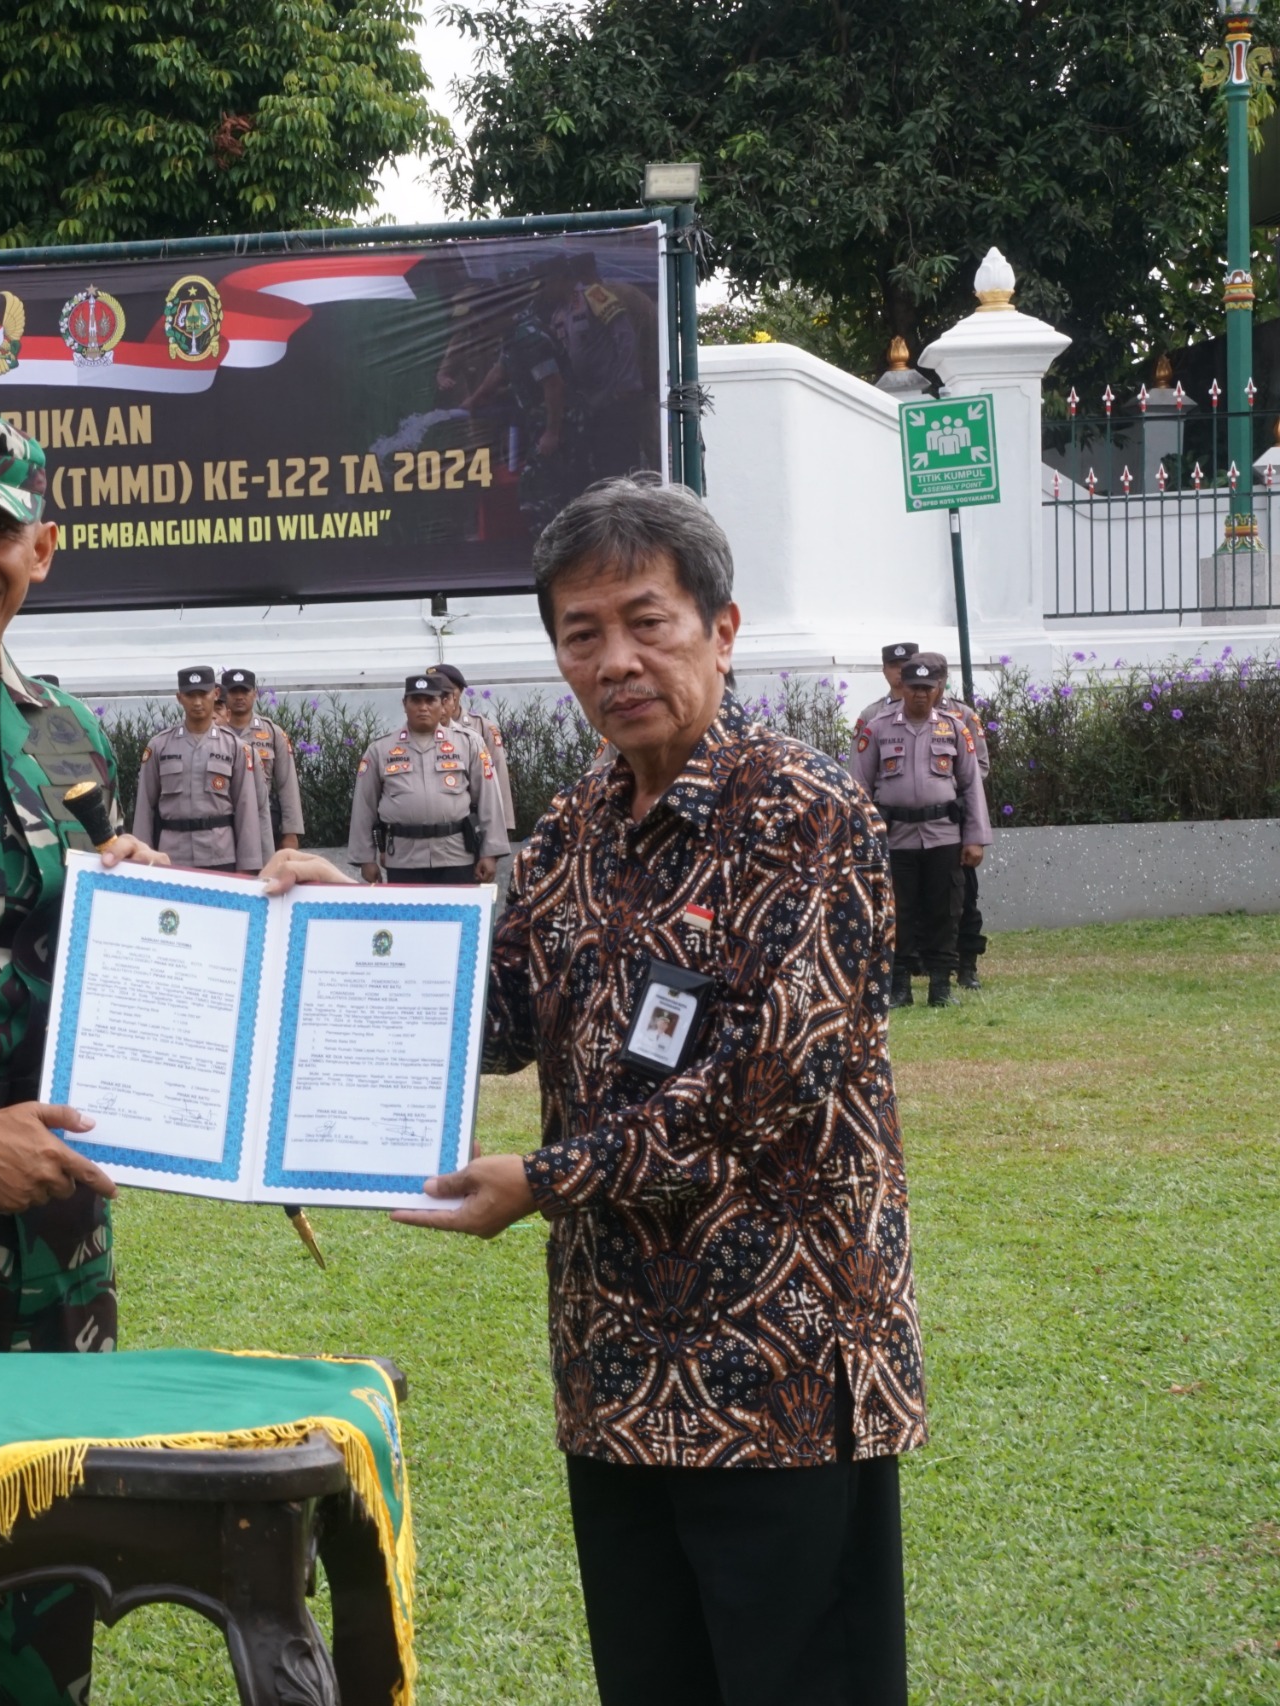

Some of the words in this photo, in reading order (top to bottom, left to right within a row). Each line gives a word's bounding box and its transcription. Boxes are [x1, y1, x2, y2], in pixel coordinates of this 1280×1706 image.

[52, 460, 193, 510] (TMMD)
[203, 456, 329, 501] KE-122
[340, 453, 384, 494] TA
[393, 447, 493, 492] 2024
[917, 473, 942, 484] TITIK
[944, 469, 986, 480] KUMPUL
[922, 483, 960, 494] ASSEMBLY
[960, 481, 983, 489] POINT
[956, 494, 995, 504] YOGYAKARTA
[72, 517, 243, 550] PEMBANGUNAN
[248, 515, 271, 542] DI
[250, 740, 274, 749] POLRI
[209, 752, 232, 763] POLRI
[436, 753, 461, 761] POLRI
